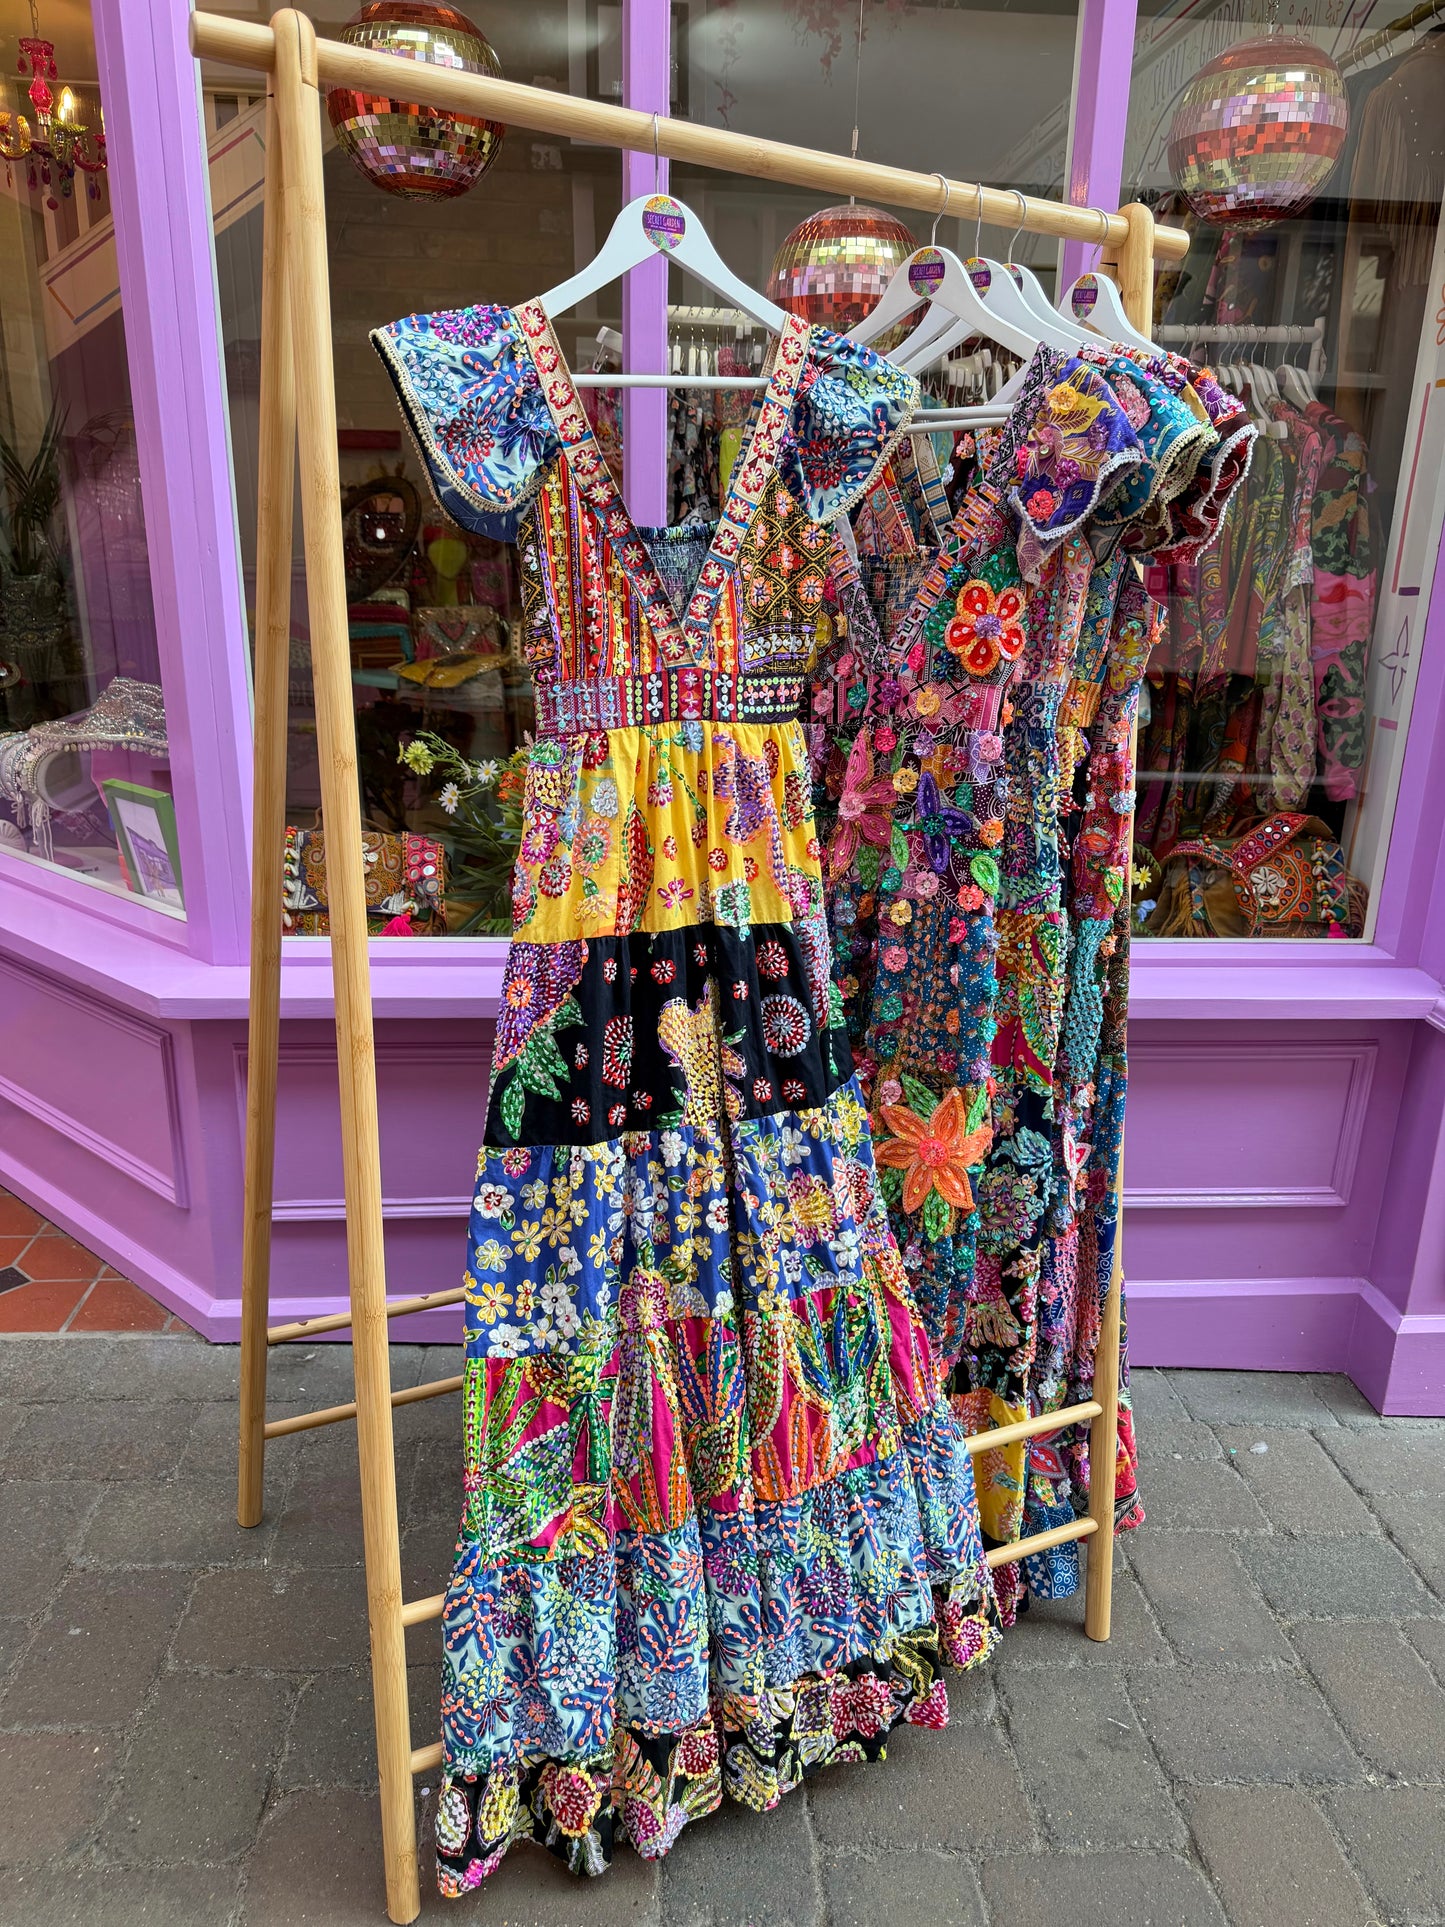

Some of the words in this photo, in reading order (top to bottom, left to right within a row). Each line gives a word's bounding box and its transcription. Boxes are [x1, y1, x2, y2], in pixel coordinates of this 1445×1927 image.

[1149, 38, 1188, 110] SECRET
[647, 214, 662, 225] SECRET
[662, 216, 681, 228] GARDEN
[925, 265, 941, 275] GARDEN
